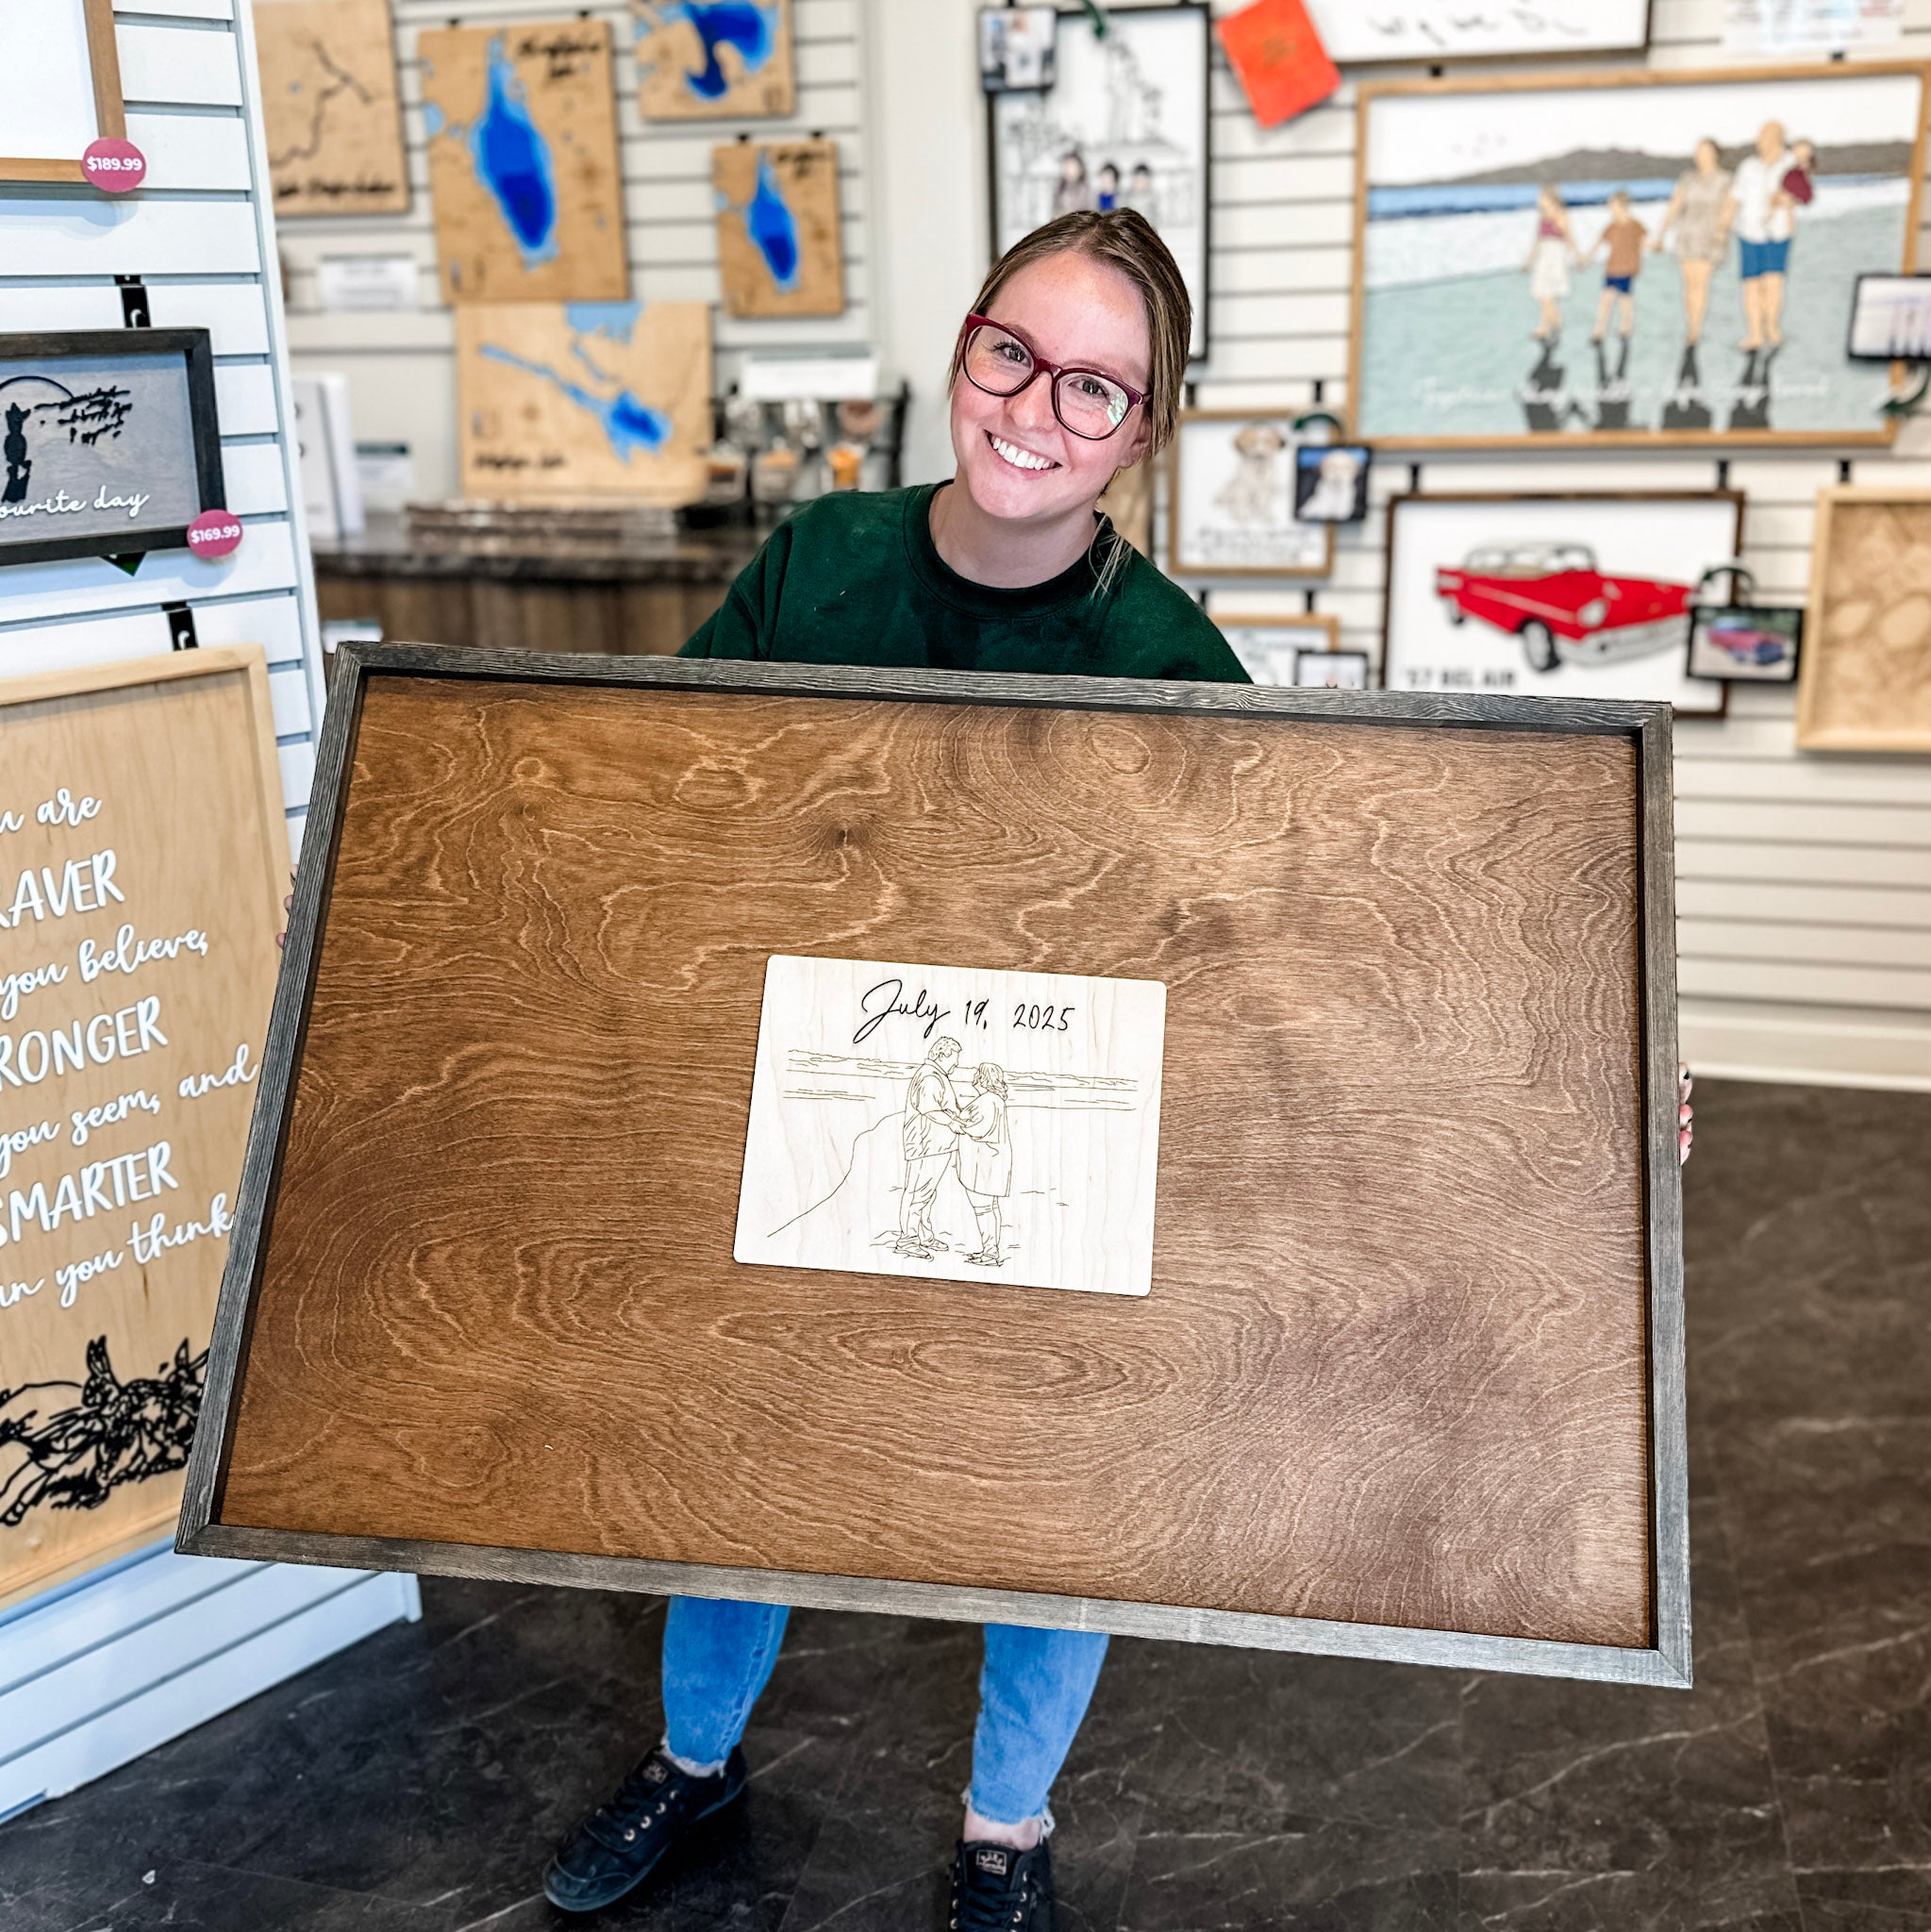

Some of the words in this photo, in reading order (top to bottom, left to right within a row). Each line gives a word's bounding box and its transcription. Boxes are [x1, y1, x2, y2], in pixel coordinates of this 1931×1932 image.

[87, 156, 142, 172] $189.99
[93, 485, 149, 518] day
[191, 525, 241, 544] $169.99
[37, 788, 102, 826] are
[0, 849, 125, 928] AVER
[78, 924, 208, 982] believe,
[852, 978, 951, 1044] July
[964, 998, 990, 1030] 19,
[1013, 1003, 1075, 1031] 2025
[71, 1090, 160, 1146] seem,
[178, 1043, 258, 1098] and
[56, 1250, 124, 1308] you
[126, 1192, 236, 1264] think
